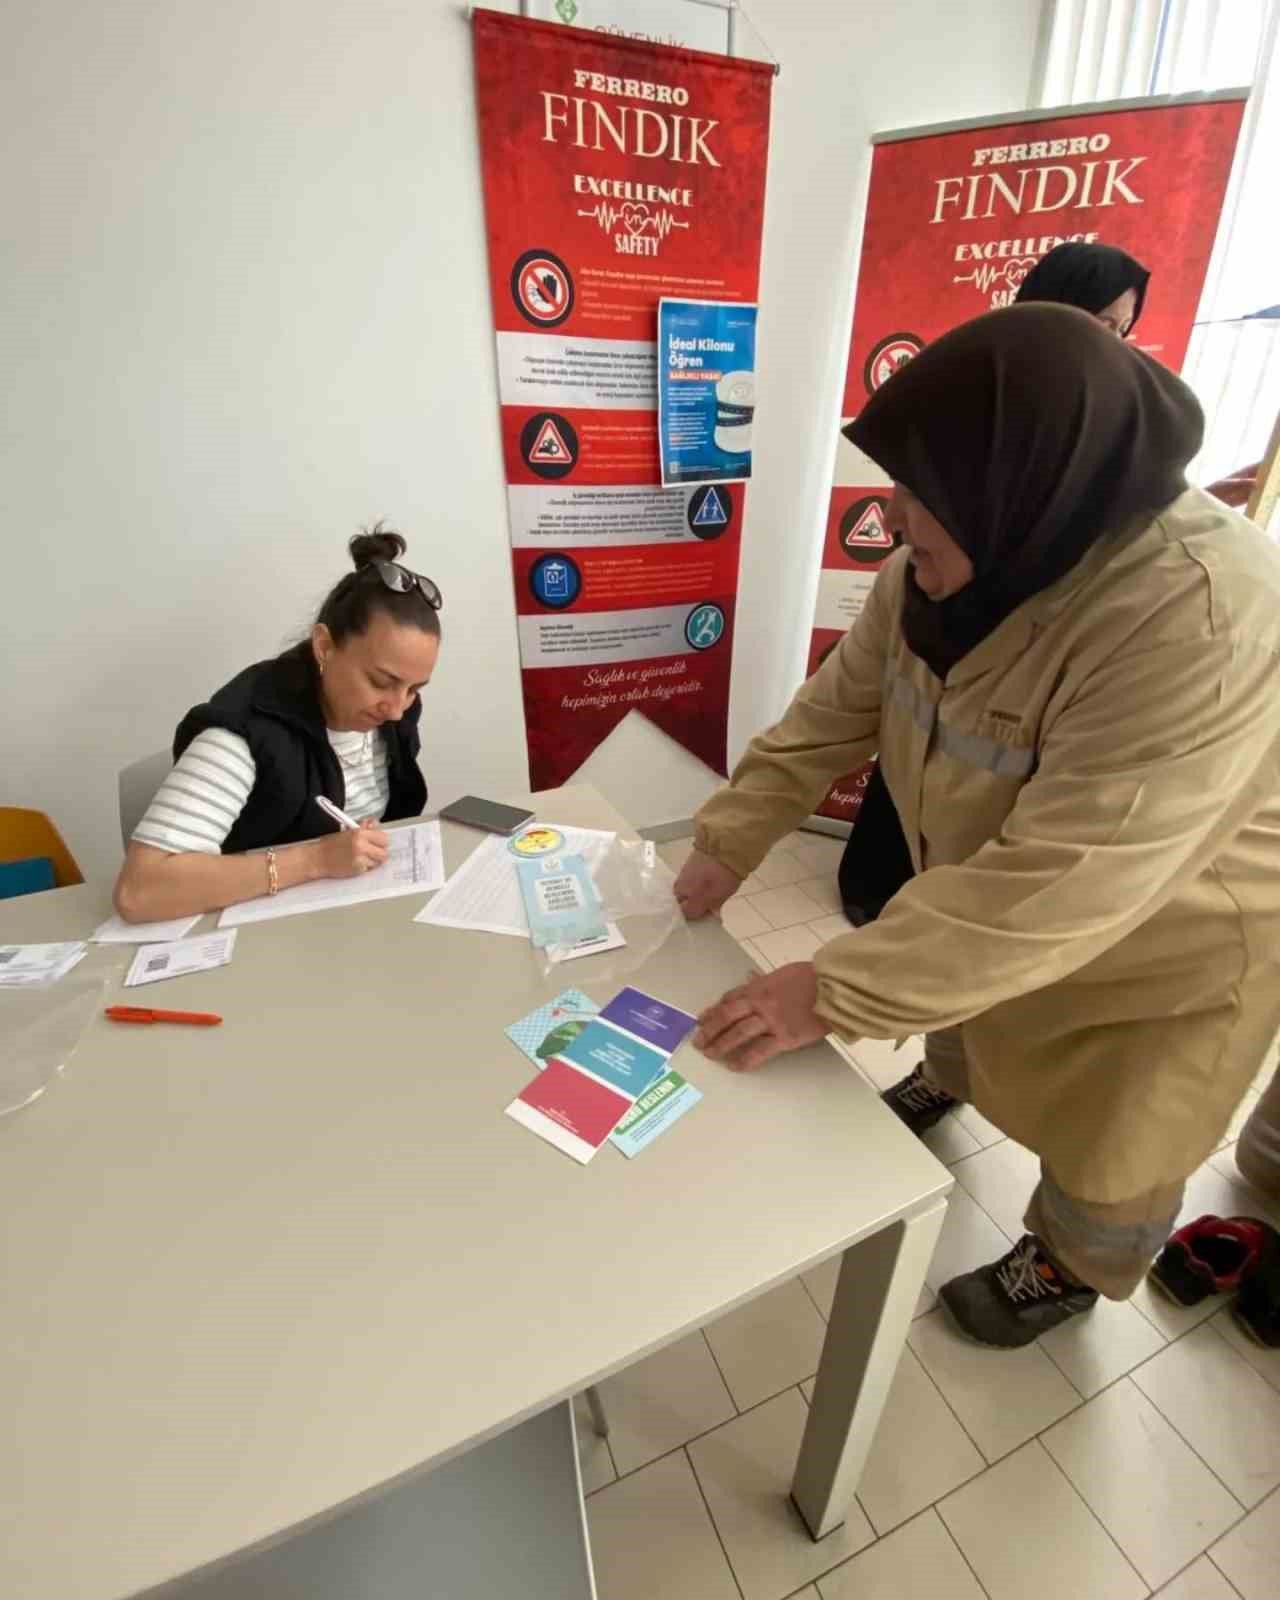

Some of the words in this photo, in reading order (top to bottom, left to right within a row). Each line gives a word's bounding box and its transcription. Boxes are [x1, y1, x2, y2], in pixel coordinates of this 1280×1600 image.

[573, 69, 689, 106] FERRERO
[539, 91, 722, 168] FINDIK
[972, 133, 1111, 166] FERRERO
[573, 174, 694, 207] EXCELLENCE
[929, 156, 1147, 225] FINDIK
[614, 233, 660, 257] SAFETY
